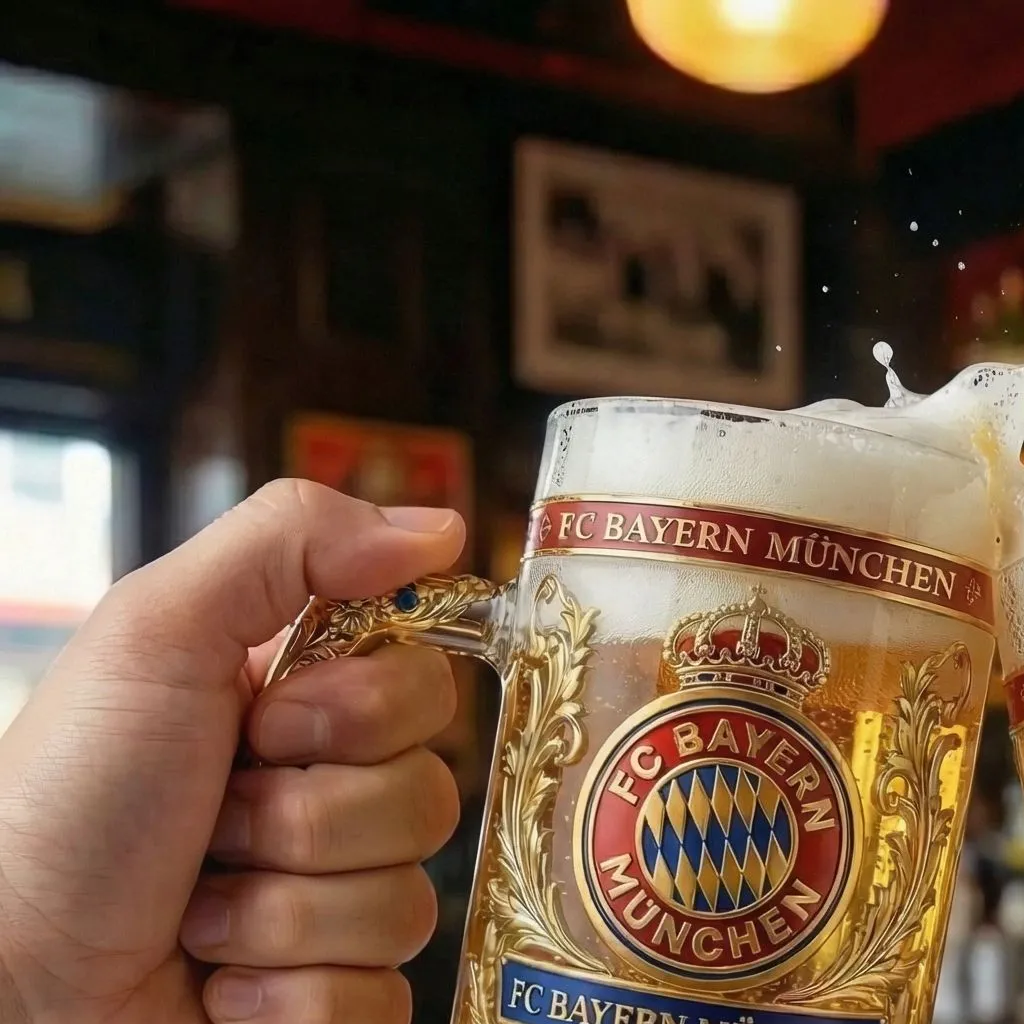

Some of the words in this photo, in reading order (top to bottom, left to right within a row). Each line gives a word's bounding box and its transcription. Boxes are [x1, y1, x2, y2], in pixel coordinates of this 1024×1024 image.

[558, 511, 597, 541] FC
[602, 513, 754, 555] BAYERN
[764, 530, 958, 600] MÜNCHEN
[608, 746, 663, 805] FC
[672, 718, 836, 832] BAYERN
[600, 853, 822, 961] MÜNCHEN
[507, 977, 544, 1014] FC
